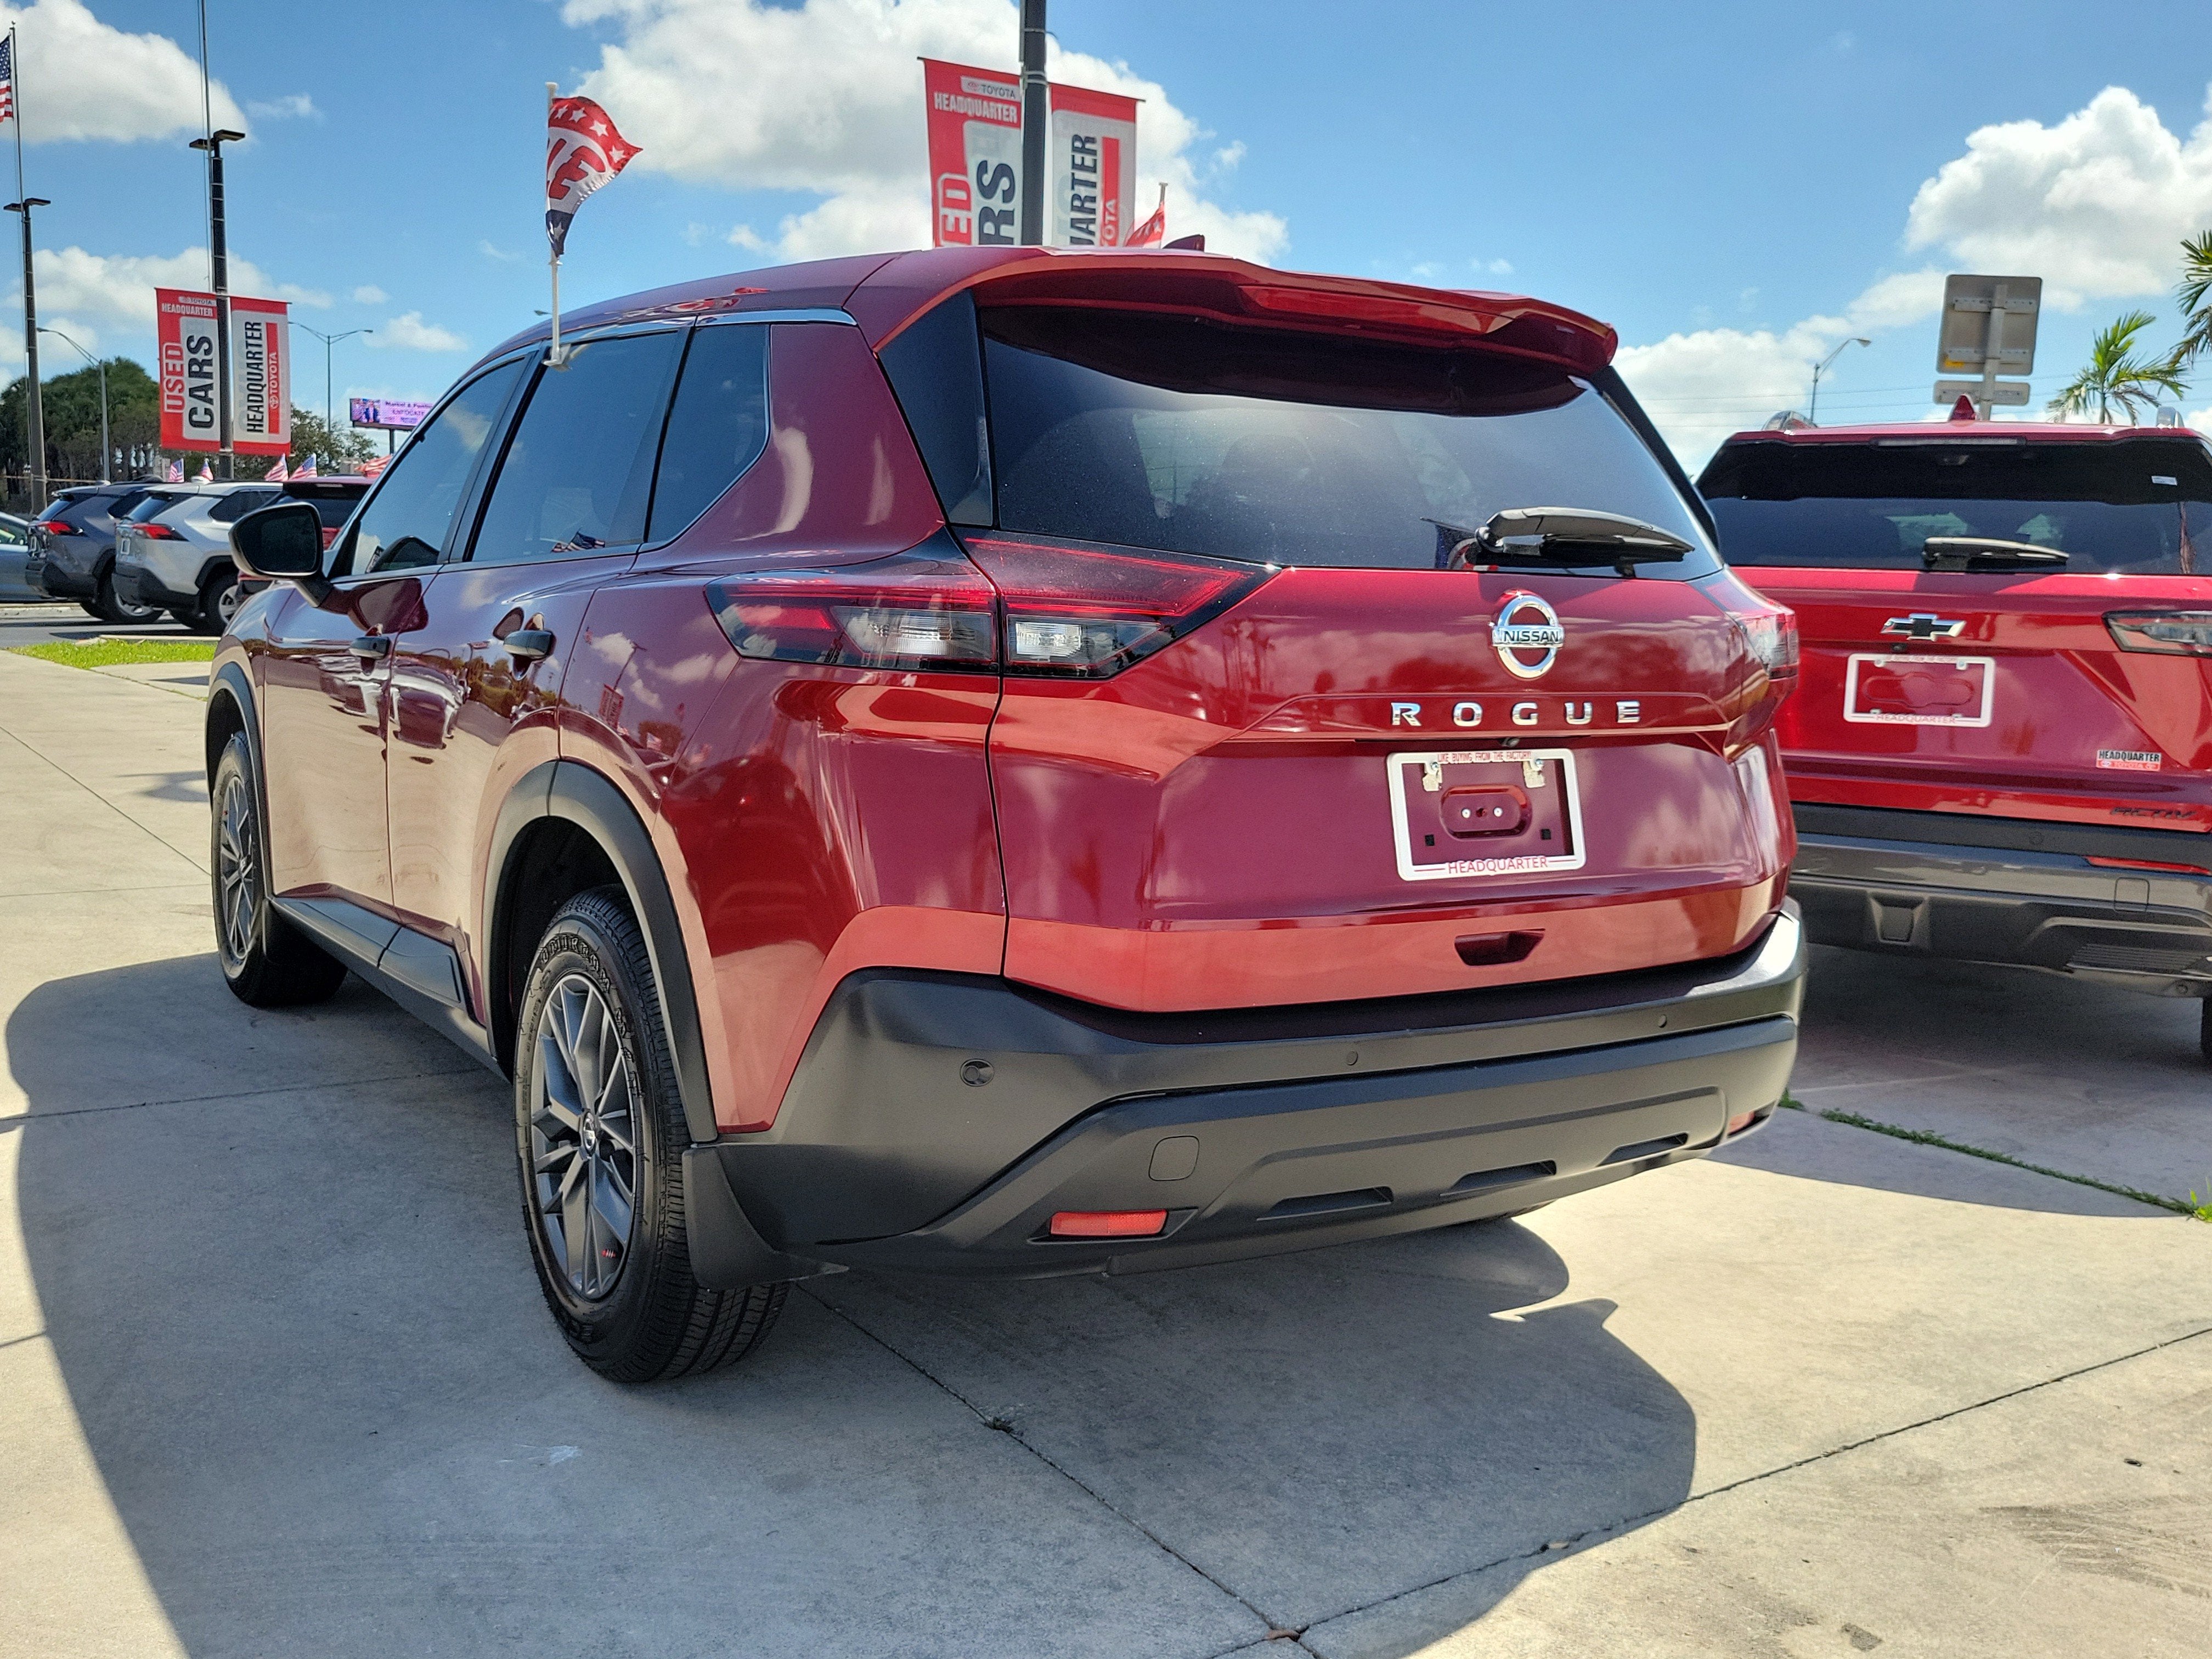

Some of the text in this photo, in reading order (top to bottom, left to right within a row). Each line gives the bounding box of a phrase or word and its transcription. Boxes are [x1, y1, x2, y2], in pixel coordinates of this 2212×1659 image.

[980, 84, 1016, 99] TOYOTA
[934, 91, 1018, 124] HEADQUARTER
[941, 177, 972, 246] ED
[976, 160, 1016, 245] RS
[161, 303, 213, 317] HEADQUARTER
[165, 344, 185, 411] USED
[186, 335, 215, 429] CARS
[245, 321, 267, 433] HEADQUARTER
[269, 352, 278, 398] TOYOTA
[1502, 630, 1560, 643] NISSAN
[1391, 700, 1640, 726] ROGUE
[1876, 714, 1956, 724] HEADQUARTER
[1437, 753, 1449, 762] LIKE
[1452, 752, 1472, 761] BUYING
[1475, 752, 1491, 761] FROM
[1493, 751, 1504, 760] THE
[2098, 750, 2160, 762] HEADQUARTER
[1448, 856, 1548, 874] HEADQUARTER
